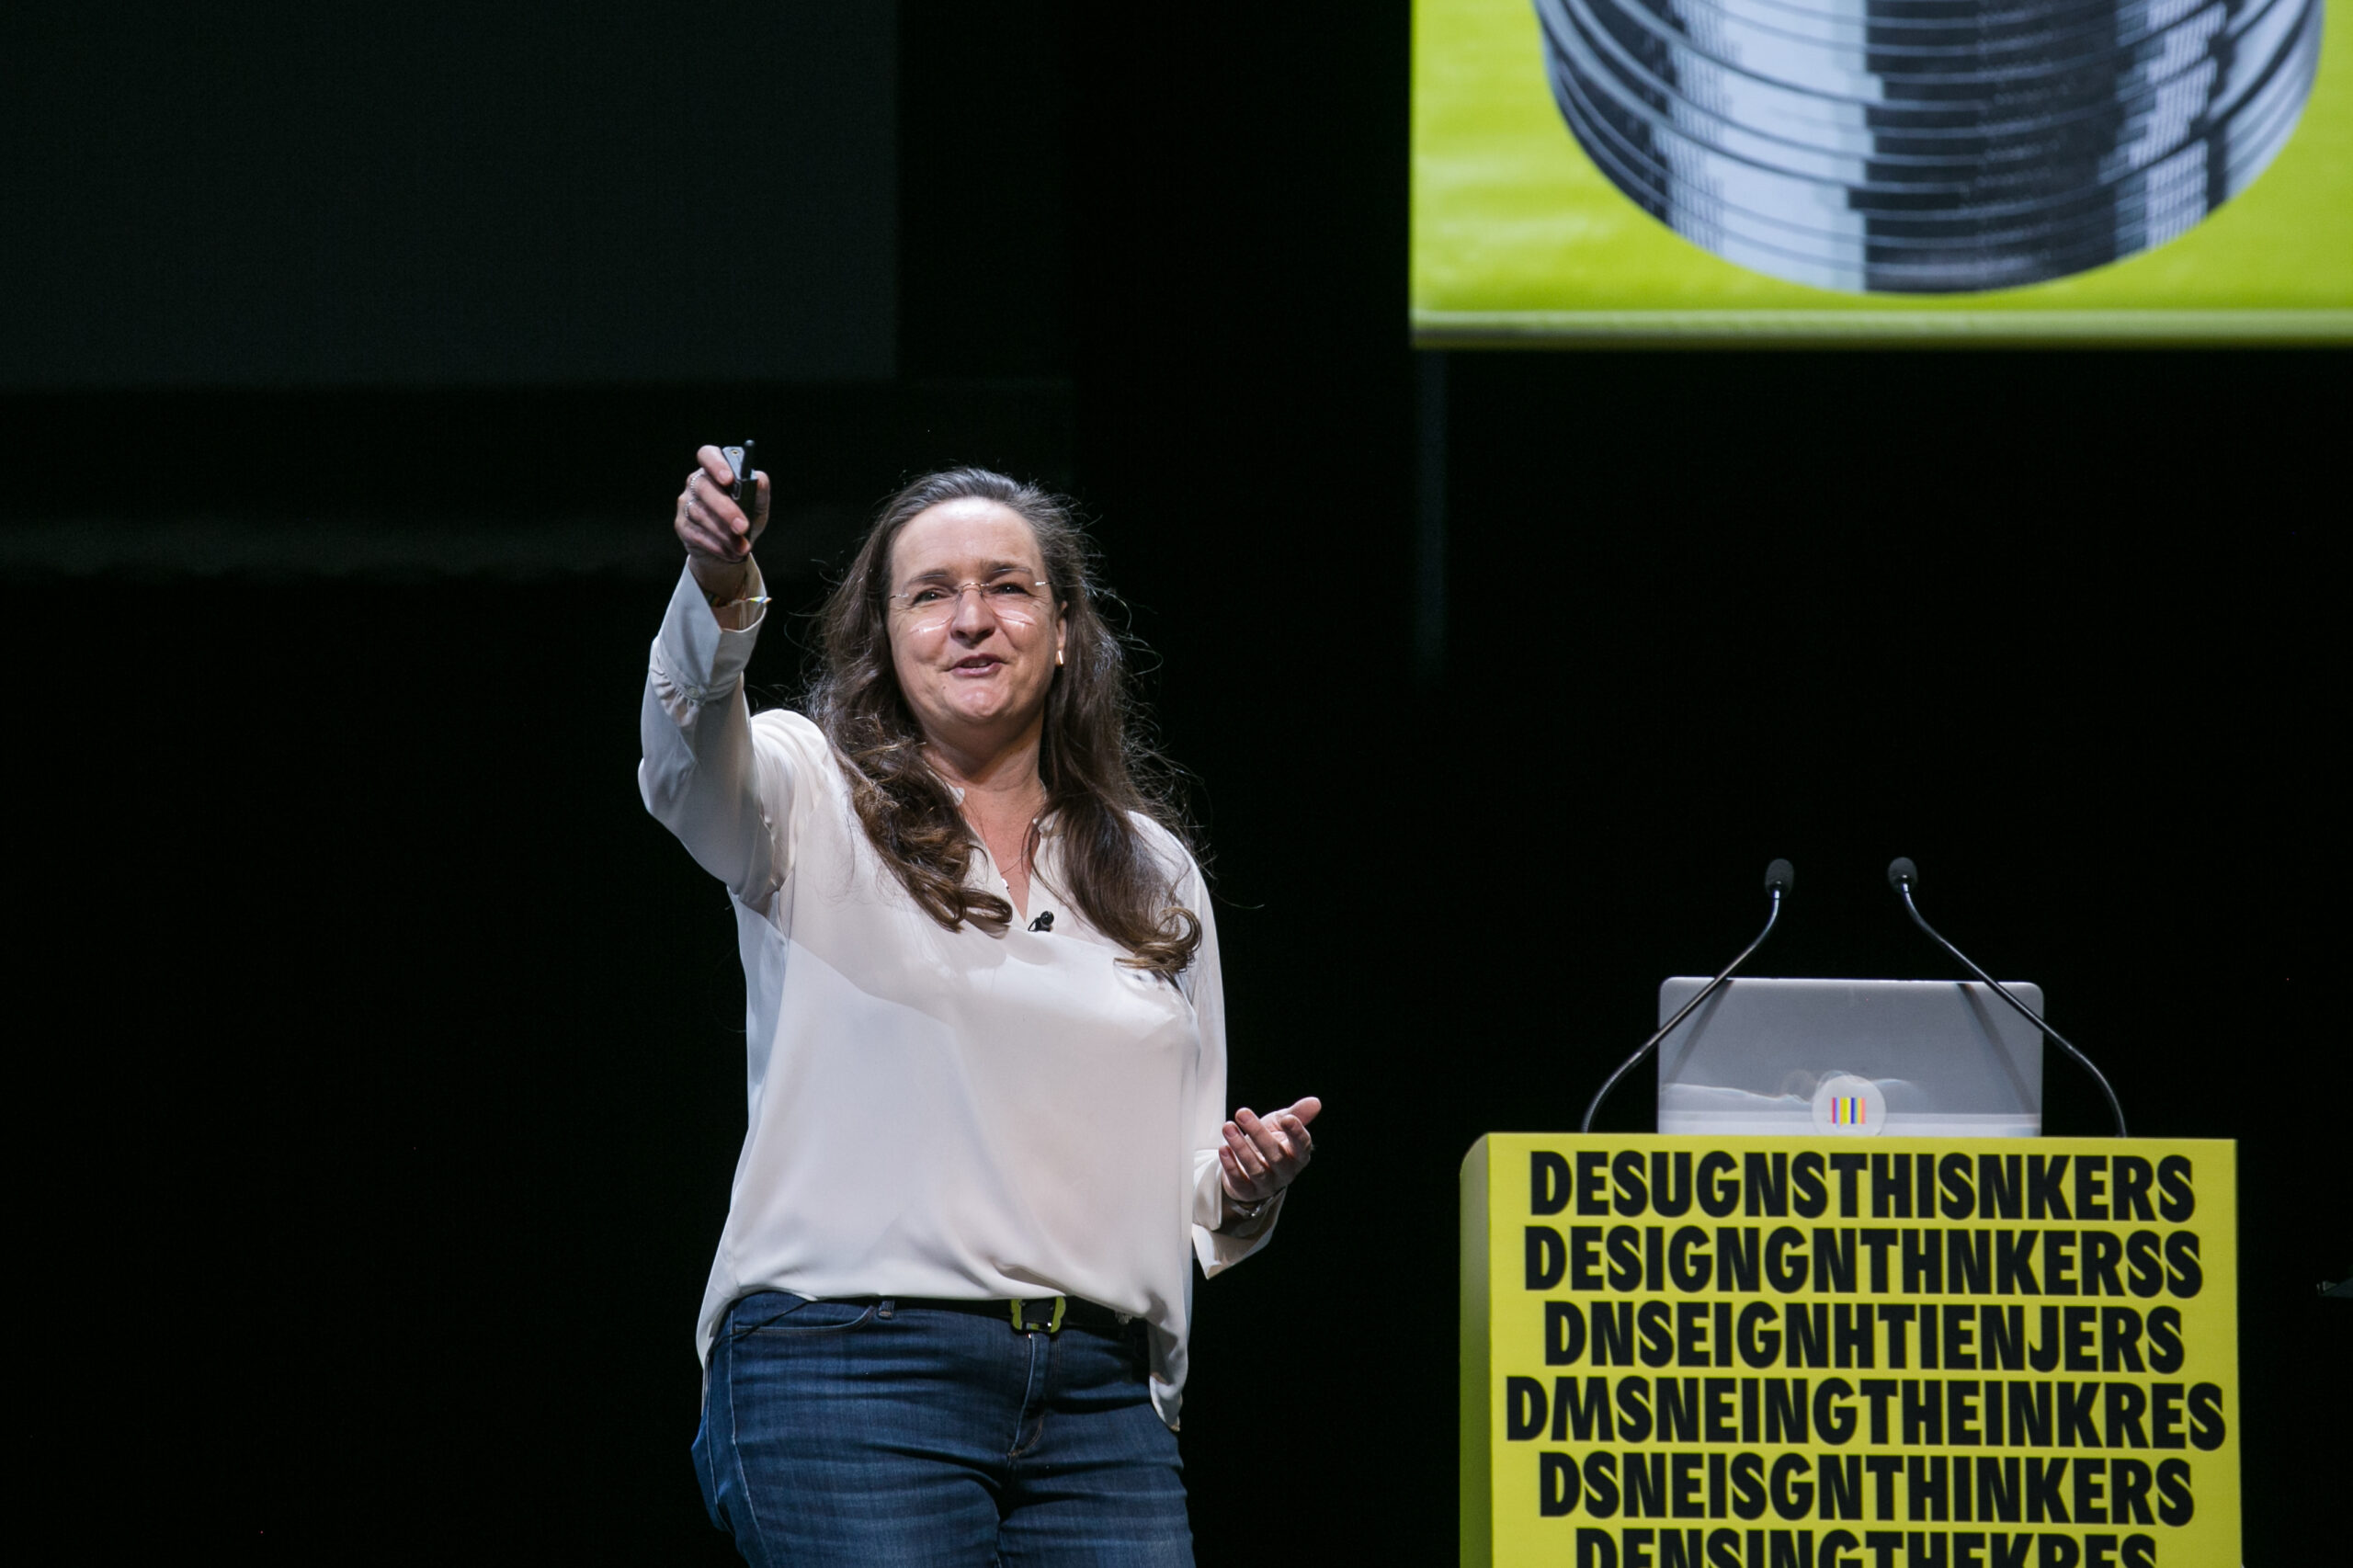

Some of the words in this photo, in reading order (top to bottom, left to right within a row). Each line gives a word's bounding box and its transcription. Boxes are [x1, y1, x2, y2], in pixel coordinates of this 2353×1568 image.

[1530, 1150, 2196, 1223] DESUGNSTHISNKERS
[1524, 1224, 2204, 1299] DESIGNGNTHNKERSS
[1544, 1300, 2186, 1374] DNSEIGNHTIENJERS
[1506, 1375, 2227, 1451] DMSNEINGTHEINKRES
[1539, 1450, 2195, 1527] DSNEISGNTHINKERS
